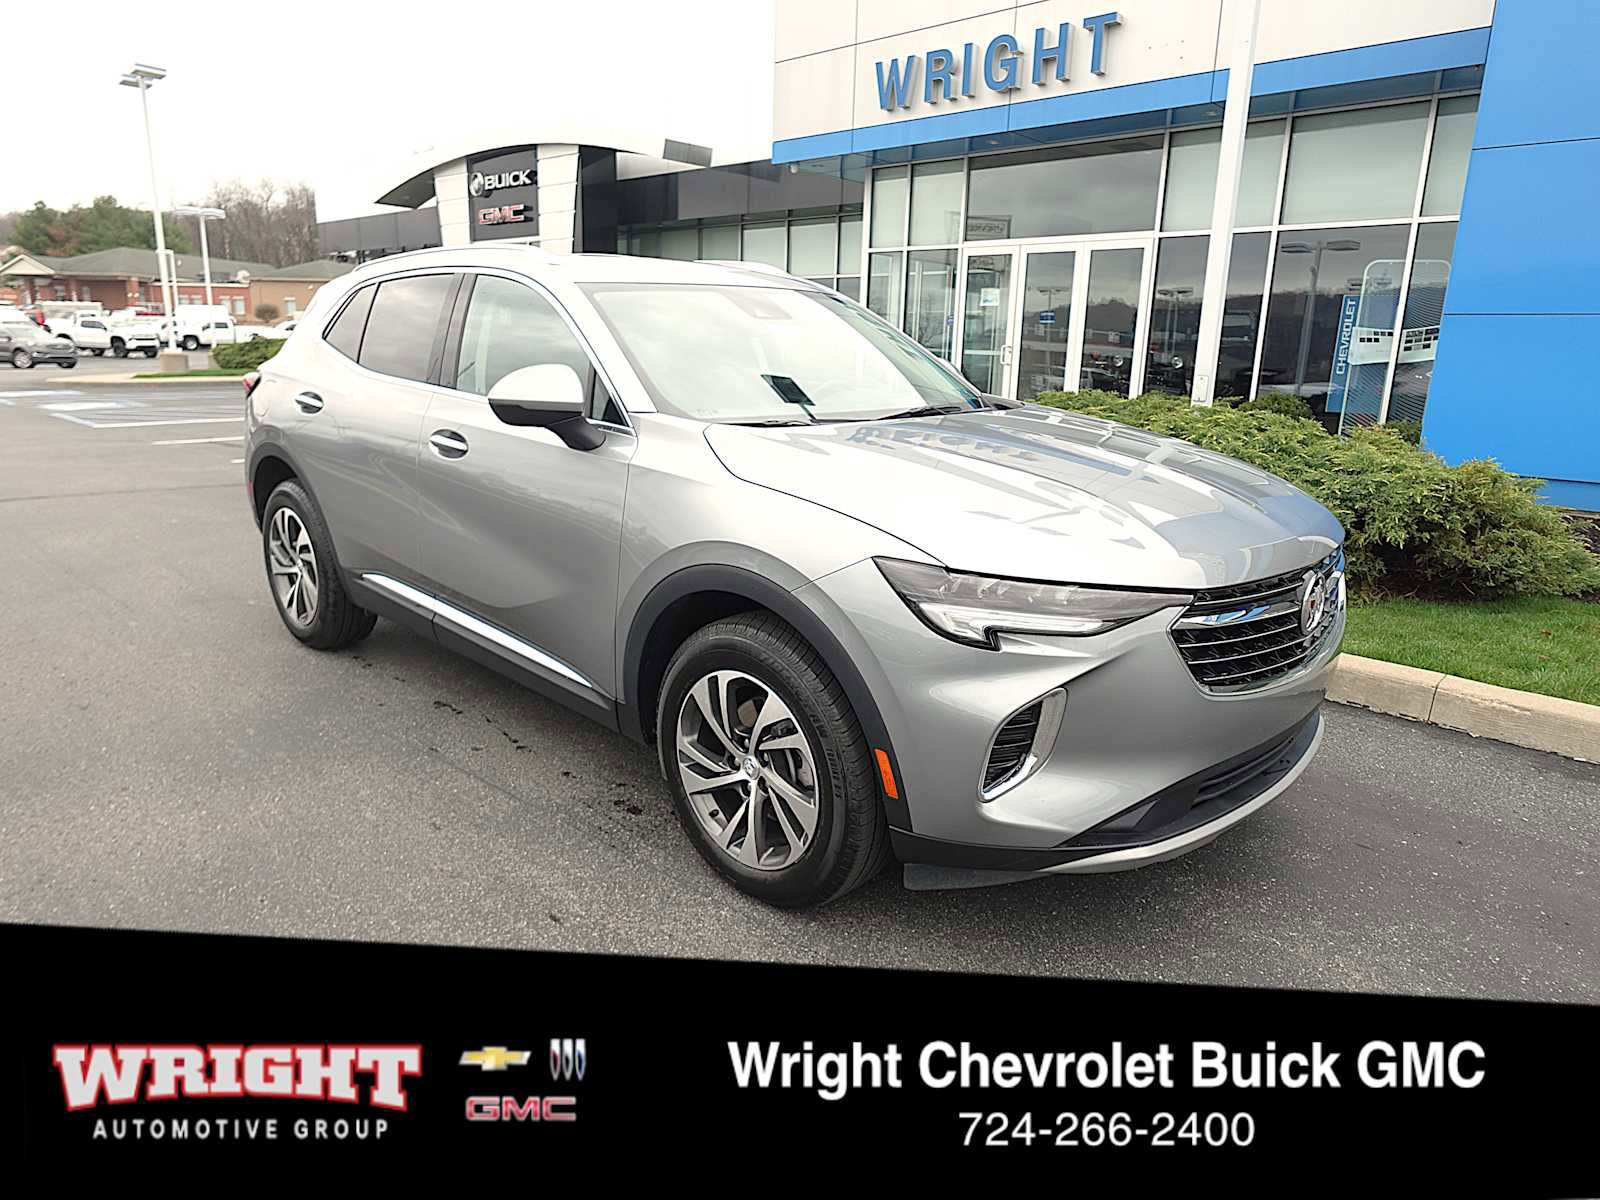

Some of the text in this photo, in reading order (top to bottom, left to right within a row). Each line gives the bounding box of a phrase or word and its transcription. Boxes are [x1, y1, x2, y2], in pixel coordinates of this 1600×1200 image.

[875, 11, 1122, 111] WRIGHT
[484, 169, 532, 190] BUICK
[479, 204, 525, 225] GMC
[1336, 299, 1357, 374] CHEVROLET
